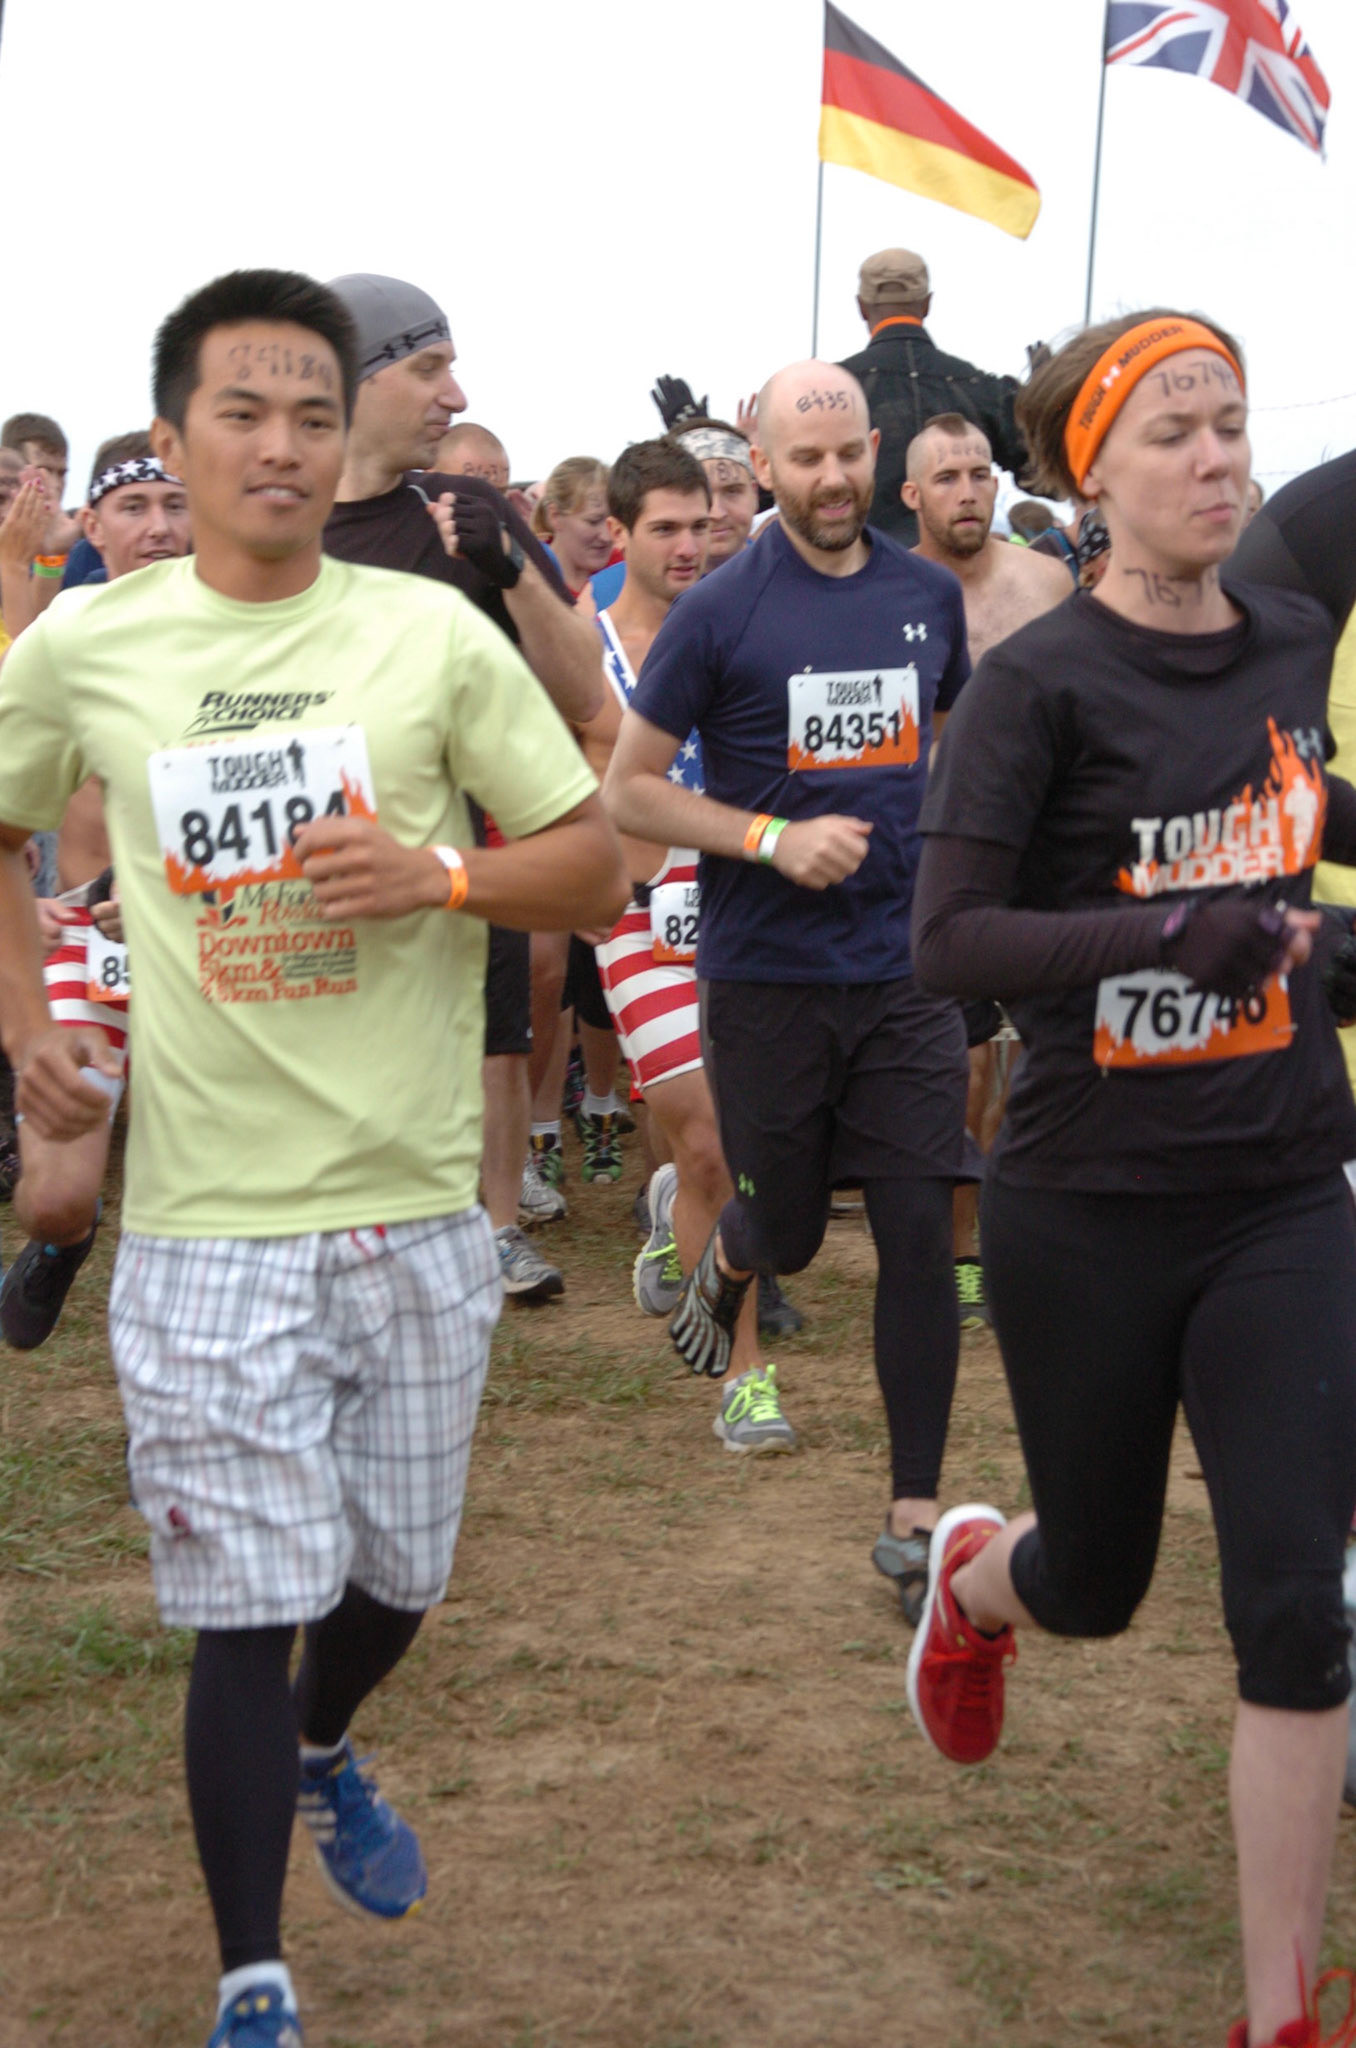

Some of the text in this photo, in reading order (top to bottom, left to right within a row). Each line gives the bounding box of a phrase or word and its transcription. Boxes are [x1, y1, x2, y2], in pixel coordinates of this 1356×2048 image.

[1118, 325, 1185, 368] MUDDER
[211, 705, 305, 723] CHOICE
[804, 710, 902, 752] 84351
[207, 750, 284, 781] TOUGH
[1130, 798, 1281, 864] TOUGH
[1131, 846, 1286, 898] MUDDER
[197, 927, 356, 958] Downtown
